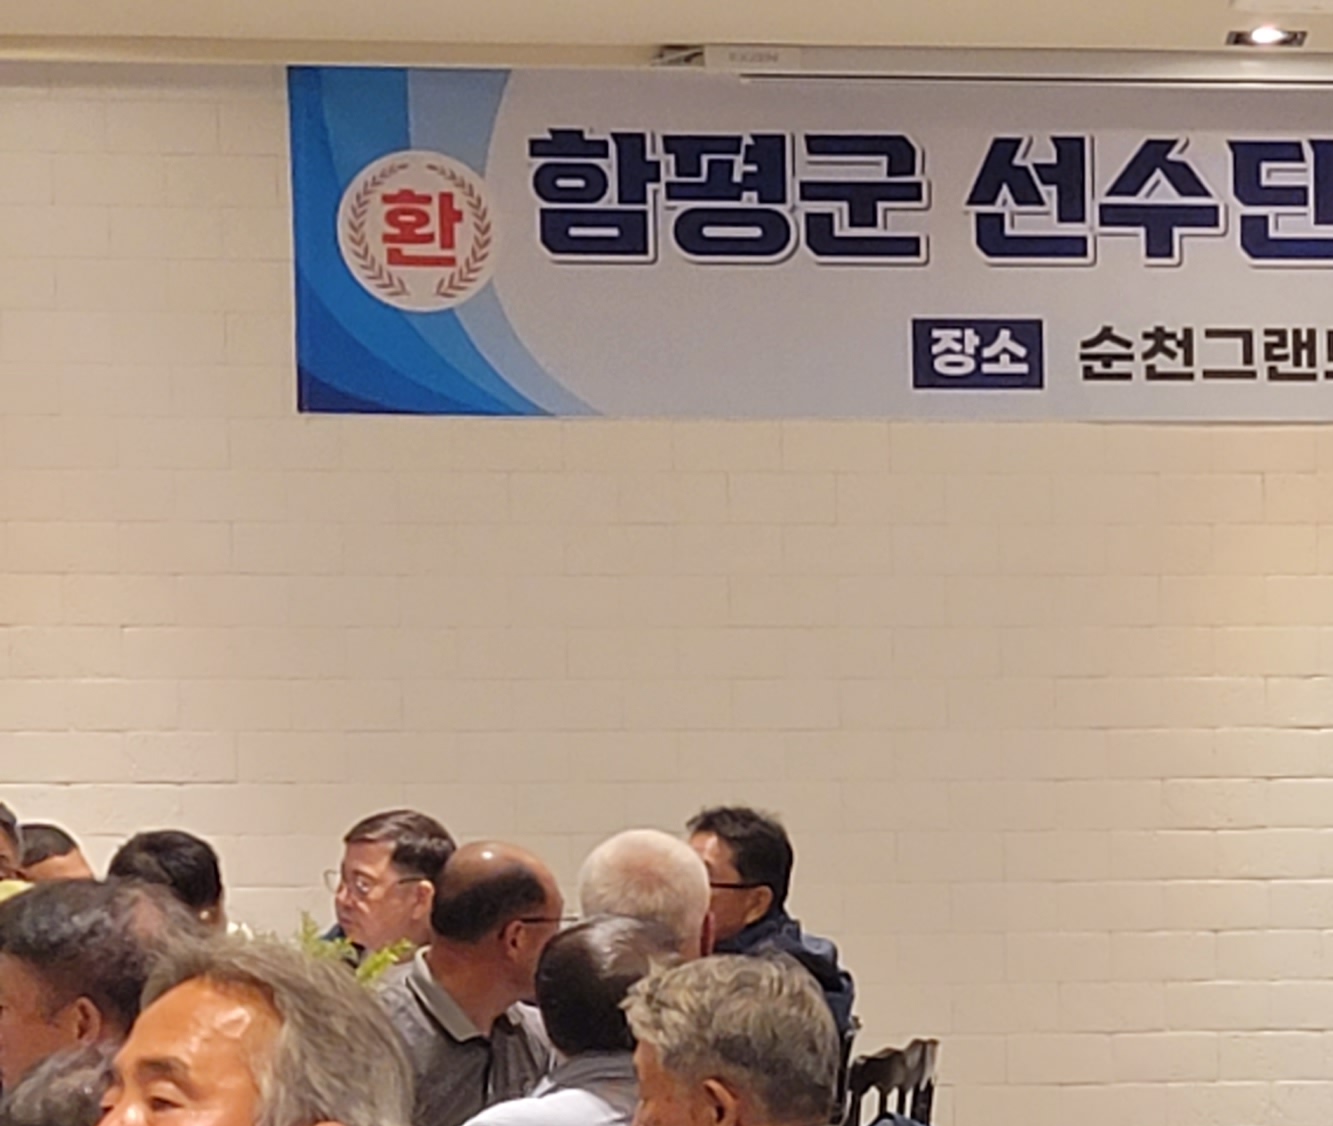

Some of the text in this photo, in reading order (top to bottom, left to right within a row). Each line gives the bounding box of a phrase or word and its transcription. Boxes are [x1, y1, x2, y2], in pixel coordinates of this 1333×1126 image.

[381, 188, 464, 267] 환
[528, 126, 930, 264] 함평군
[930, 328, 1030, 376] 장소
